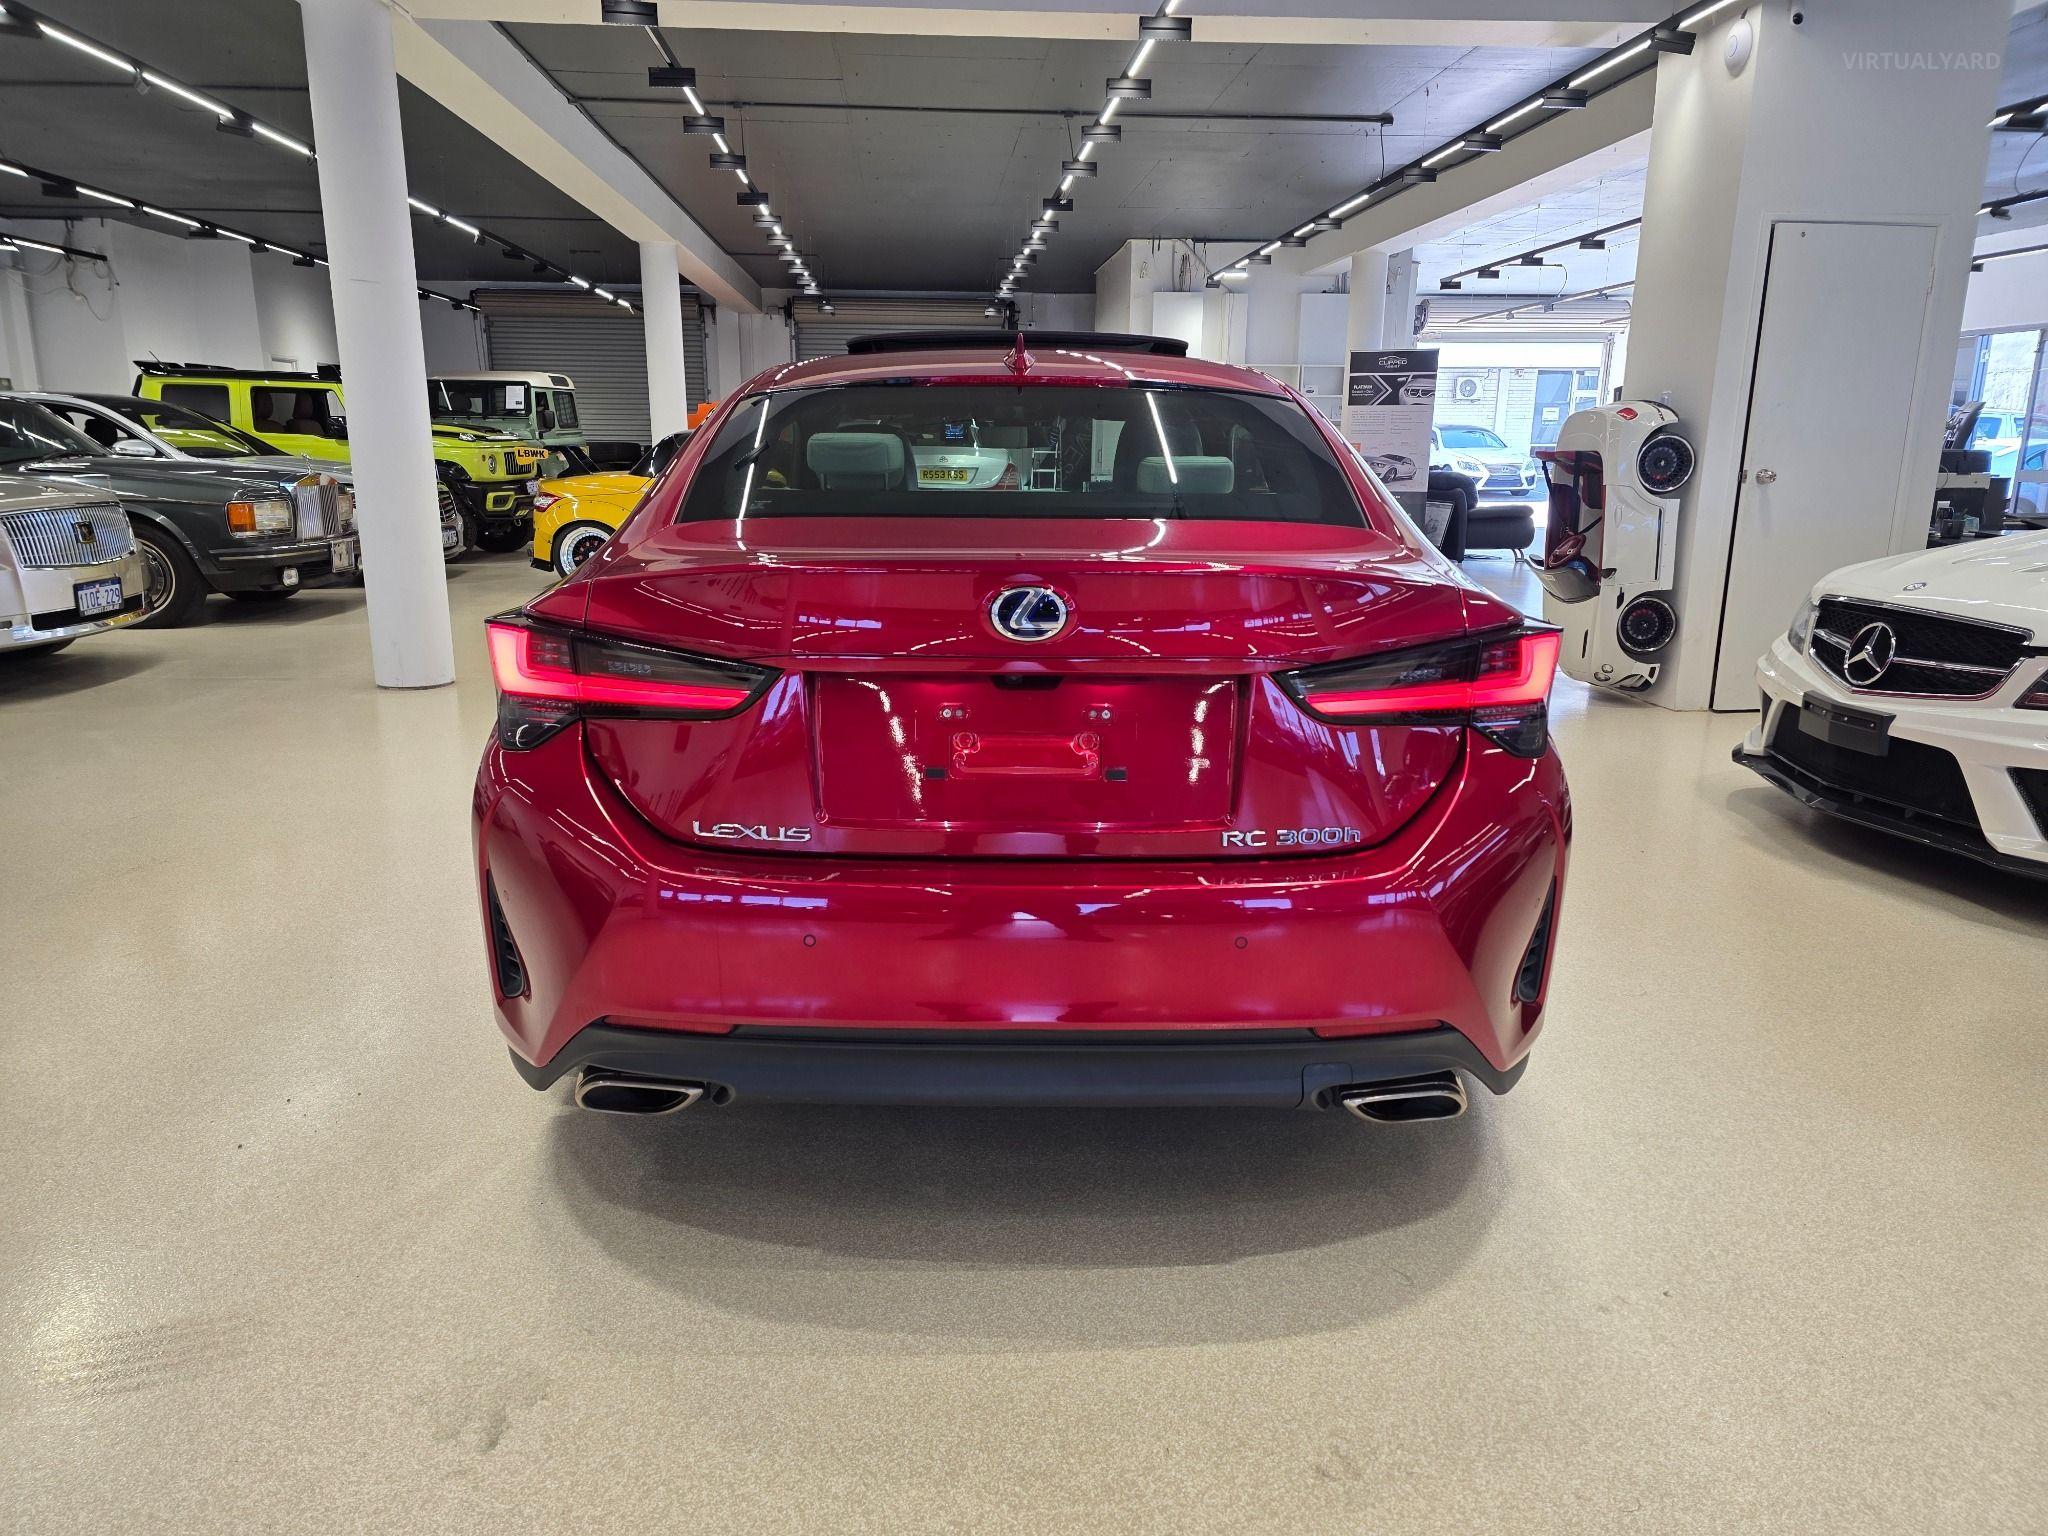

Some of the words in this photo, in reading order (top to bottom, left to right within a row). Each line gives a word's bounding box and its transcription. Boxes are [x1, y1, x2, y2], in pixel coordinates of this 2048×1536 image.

[692, 820, 811, 842] LEXUS
[1221, 830, 1267, 847] RC
[1276, 826, 1361, 846] 300h
